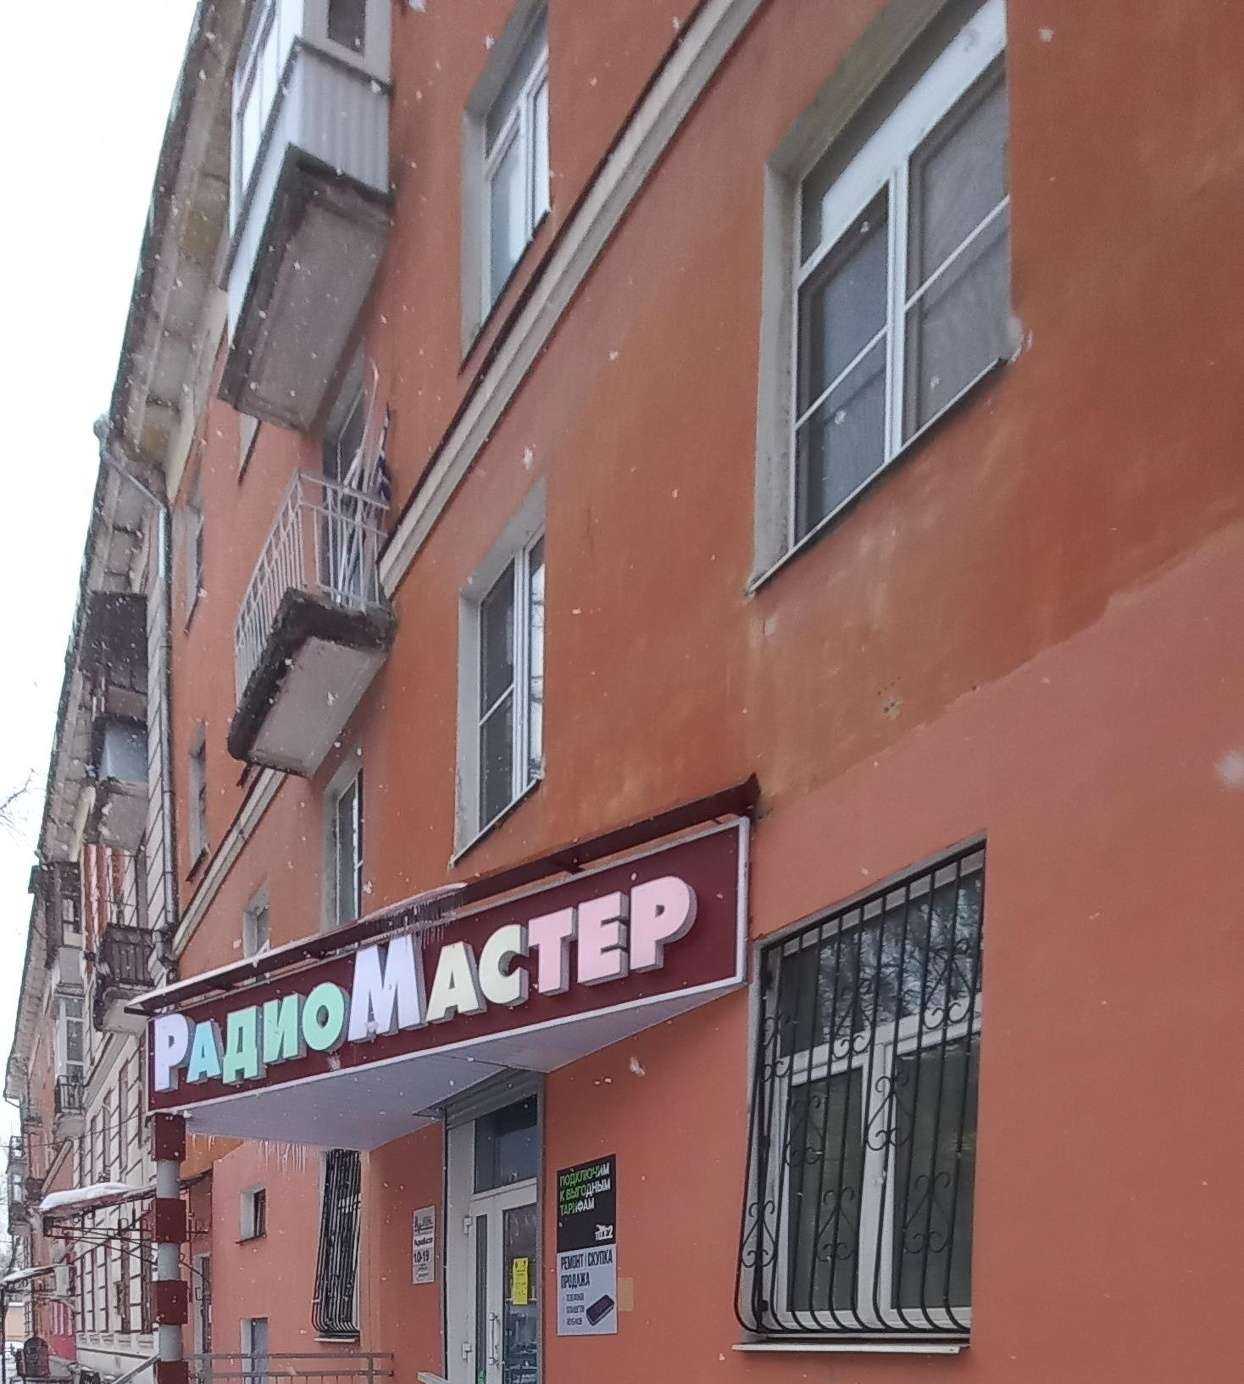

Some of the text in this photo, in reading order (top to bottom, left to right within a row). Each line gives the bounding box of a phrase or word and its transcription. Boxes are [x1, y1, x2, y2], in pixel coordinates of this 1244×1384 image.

[560, 1197, 595, 1217] ТАРИФАМ
[561, 1253, 584, 1270] РЕМОНТ
[560, 1271, 591, 1289] ПРОДАЖА
